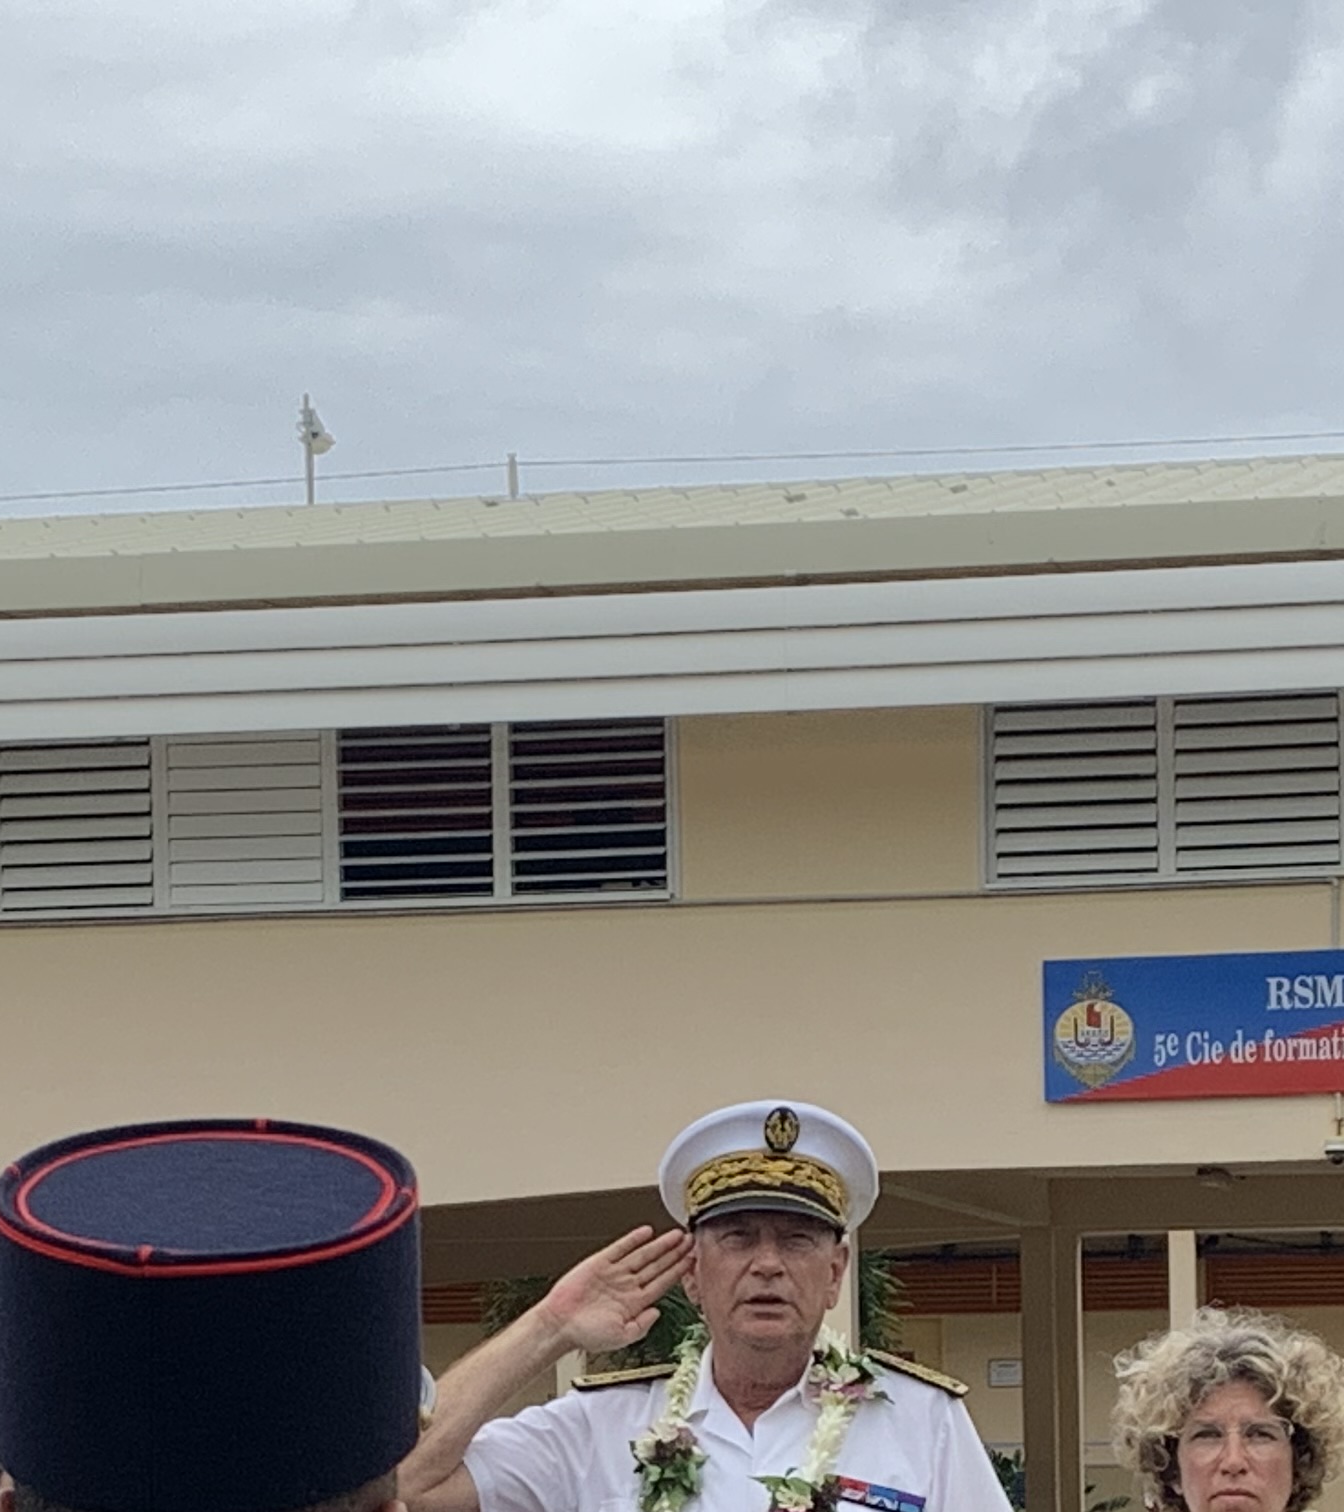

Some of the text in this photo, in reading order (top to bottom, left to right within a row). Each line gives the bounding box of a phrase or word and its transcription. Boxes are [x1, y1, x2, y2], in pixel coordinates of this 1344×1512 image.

[1154, 1033, 1179, 1067] 5e
[1186, 1031, 1223, 1065] Cie
[1230, 1029, 1257, 1064] de
